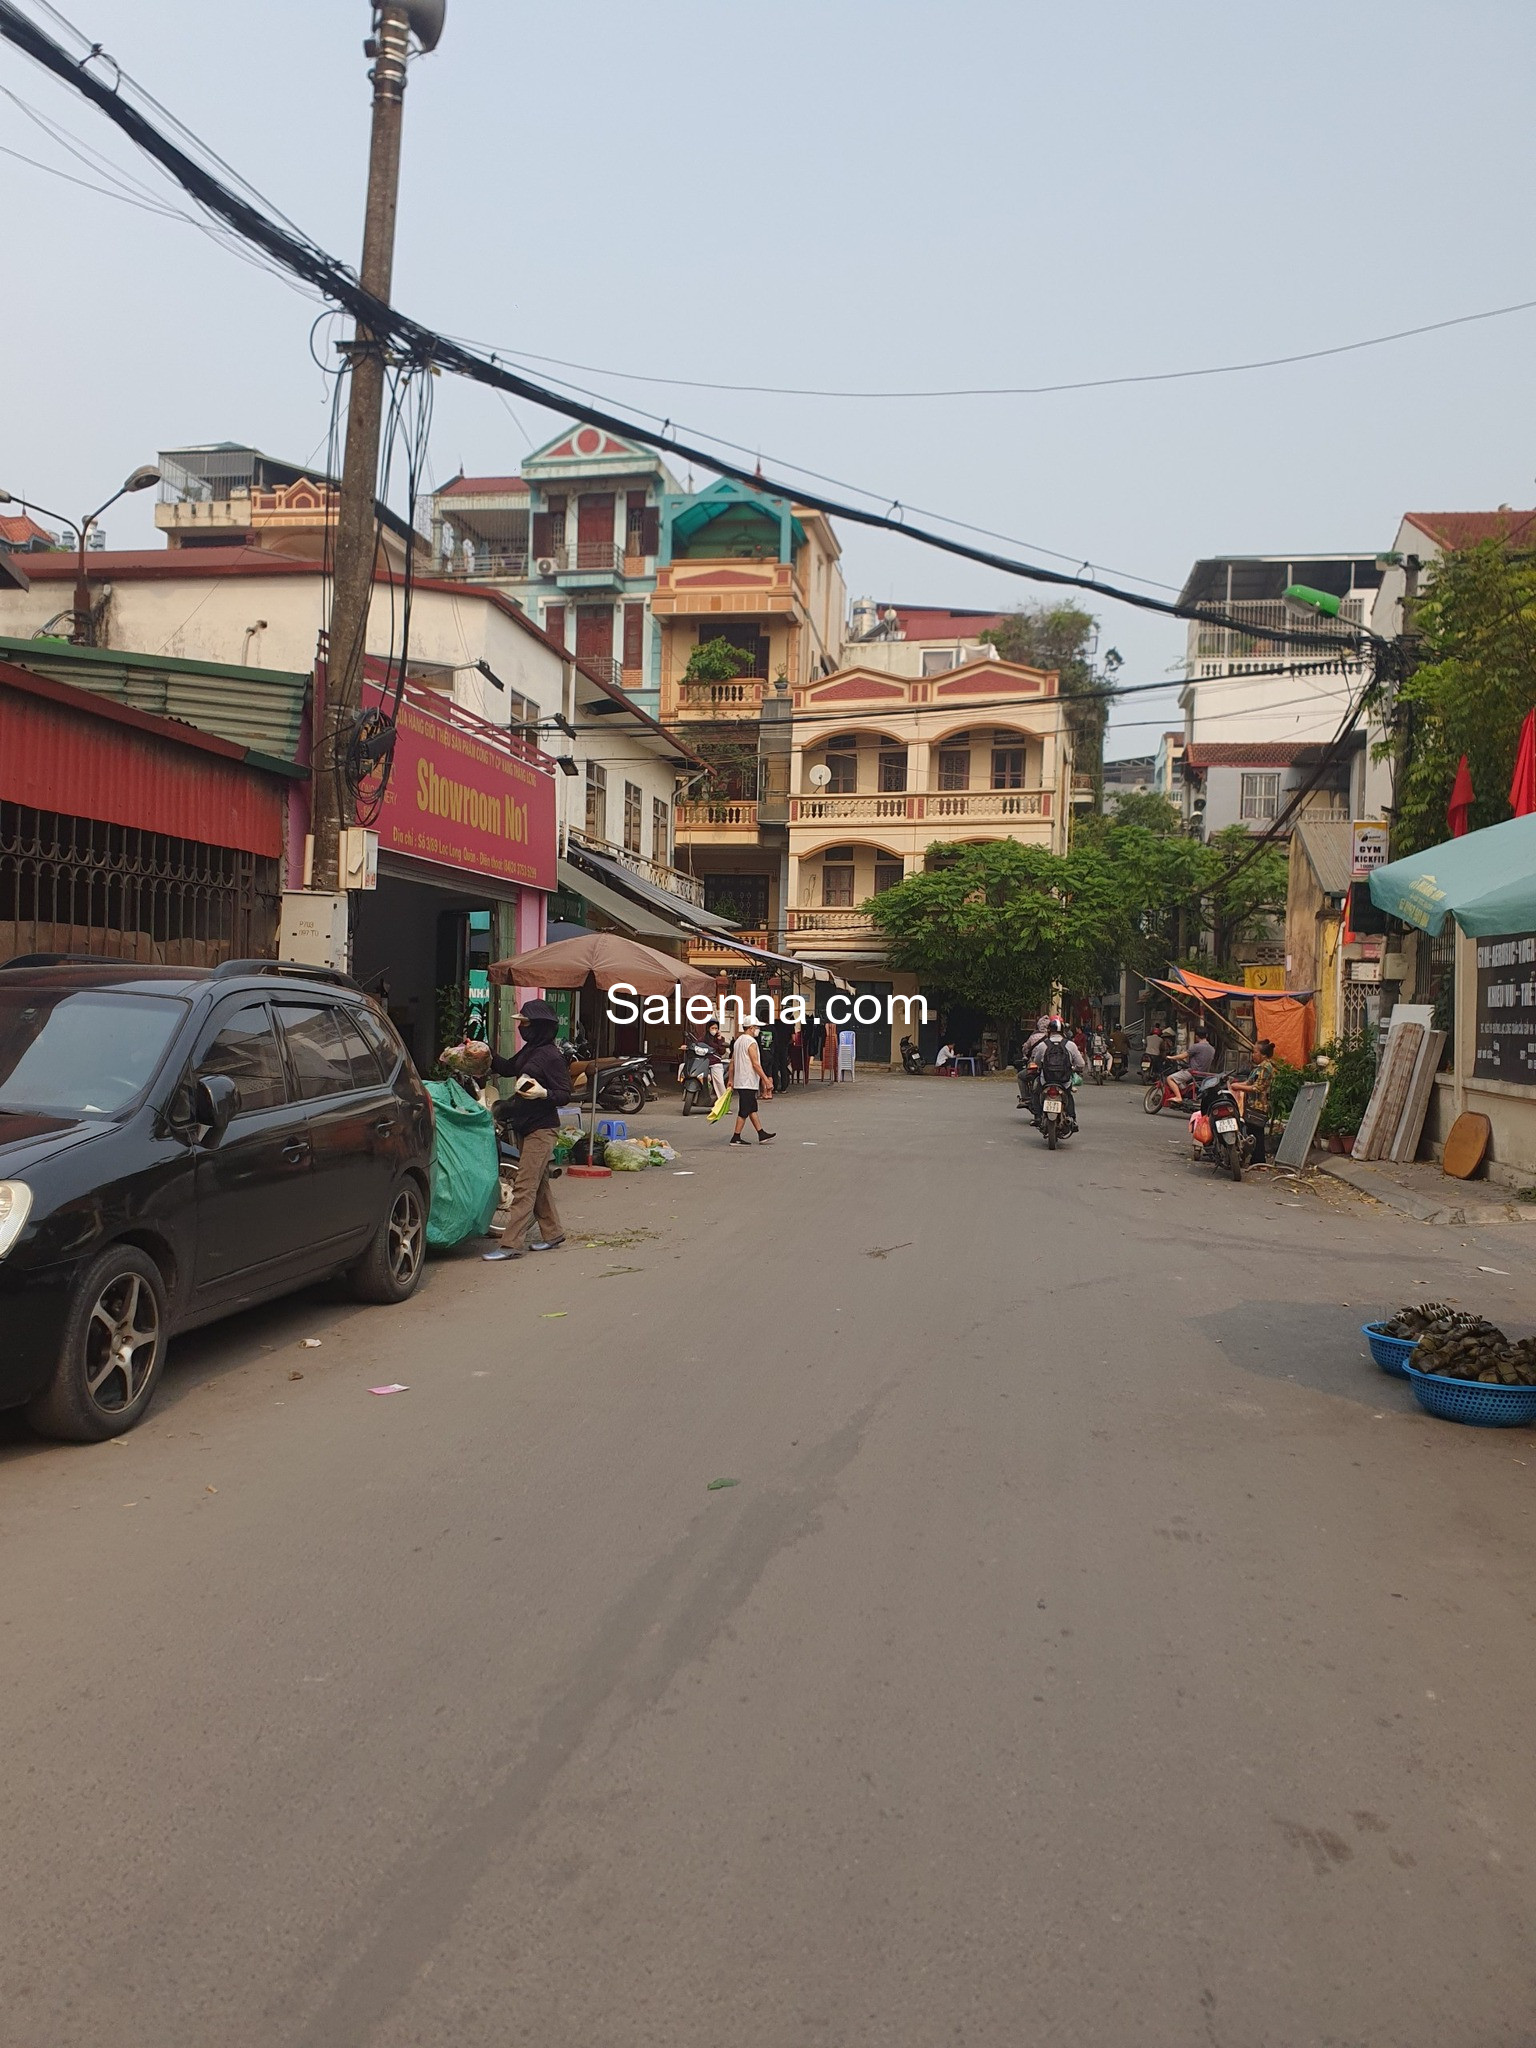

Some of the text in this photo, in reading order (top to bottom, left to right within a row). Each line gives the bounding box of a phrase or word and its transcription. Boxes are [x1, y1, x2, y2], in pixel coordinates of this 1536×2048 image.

[416, 757, 529, 846] Showroom No1
[417, 831, 426, 850] Số
[449, 842, 462, 862] Long
